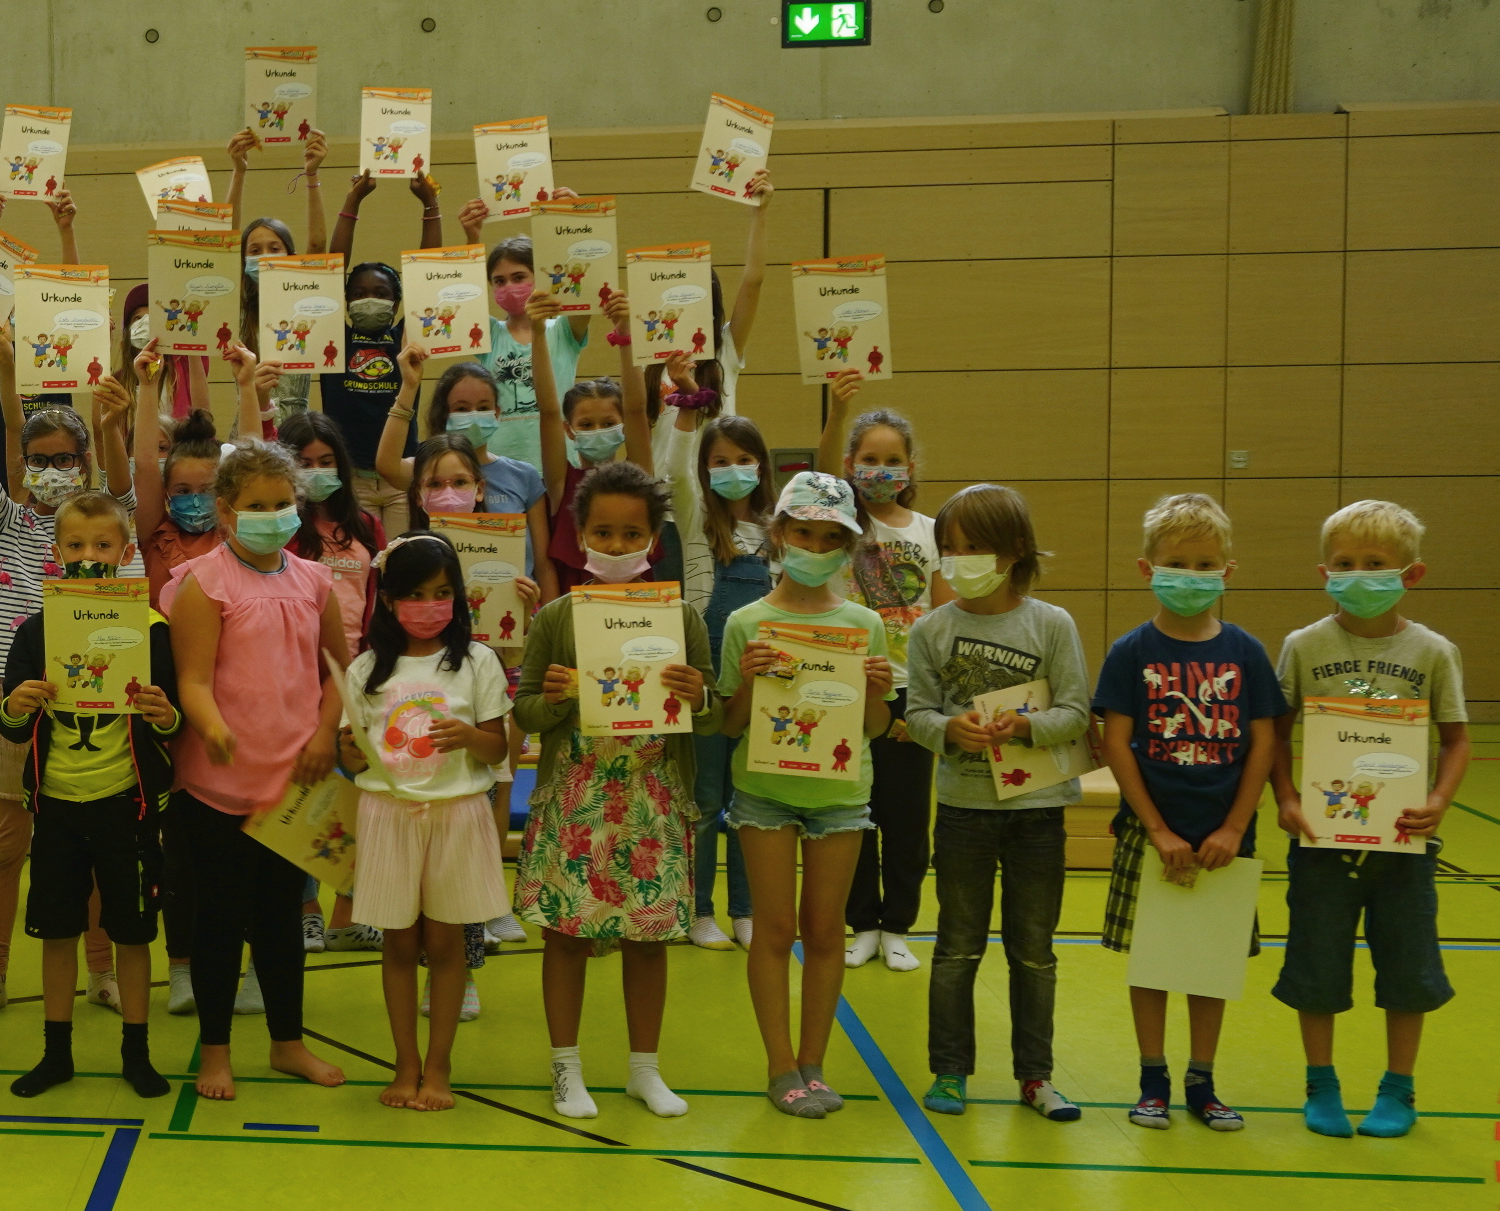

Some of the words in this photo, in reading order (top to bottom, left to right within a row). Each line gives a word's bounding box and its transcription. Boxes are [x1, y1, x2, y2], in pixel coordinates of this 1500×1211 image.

[265, 69, 297, 78] Urkunde
[555, 225, 594, 235] Urkunde
[174, 258, 214, 269] Urkunde
[426, 270, 463, 281] Urkunde
[650, 269, 687, 282] Urkunde
[282, 281, 320, 291] Urkunde
[819, 286, 860, 298] Urkunde
[40, 292, 82, 303] Urkunde
[343, 379, 399, 390] GRUNDSCHULE
[456, 541, 498, 554] Urkunde
[883, 540, 922, 556] HARD
[318, 555, 362, 570] adidas
[73, 608, 120, 621] Urkunde
[604, 617, 653, 630] Urkunde
[958, 640, 1037, 672] WARNING
[801, 661, 836, 673] kunde
[1312, 659, 1362, 681] FIERCE
[1367, 659, 1427, 687] FRIENDS
[1146, 661, 1242, 701] DINO
[1147, 702, 1242, 738] SAUR
[1338, 731, 1392, 745] Urkunde
[1147, 739, 1241, 765] EXPERT
